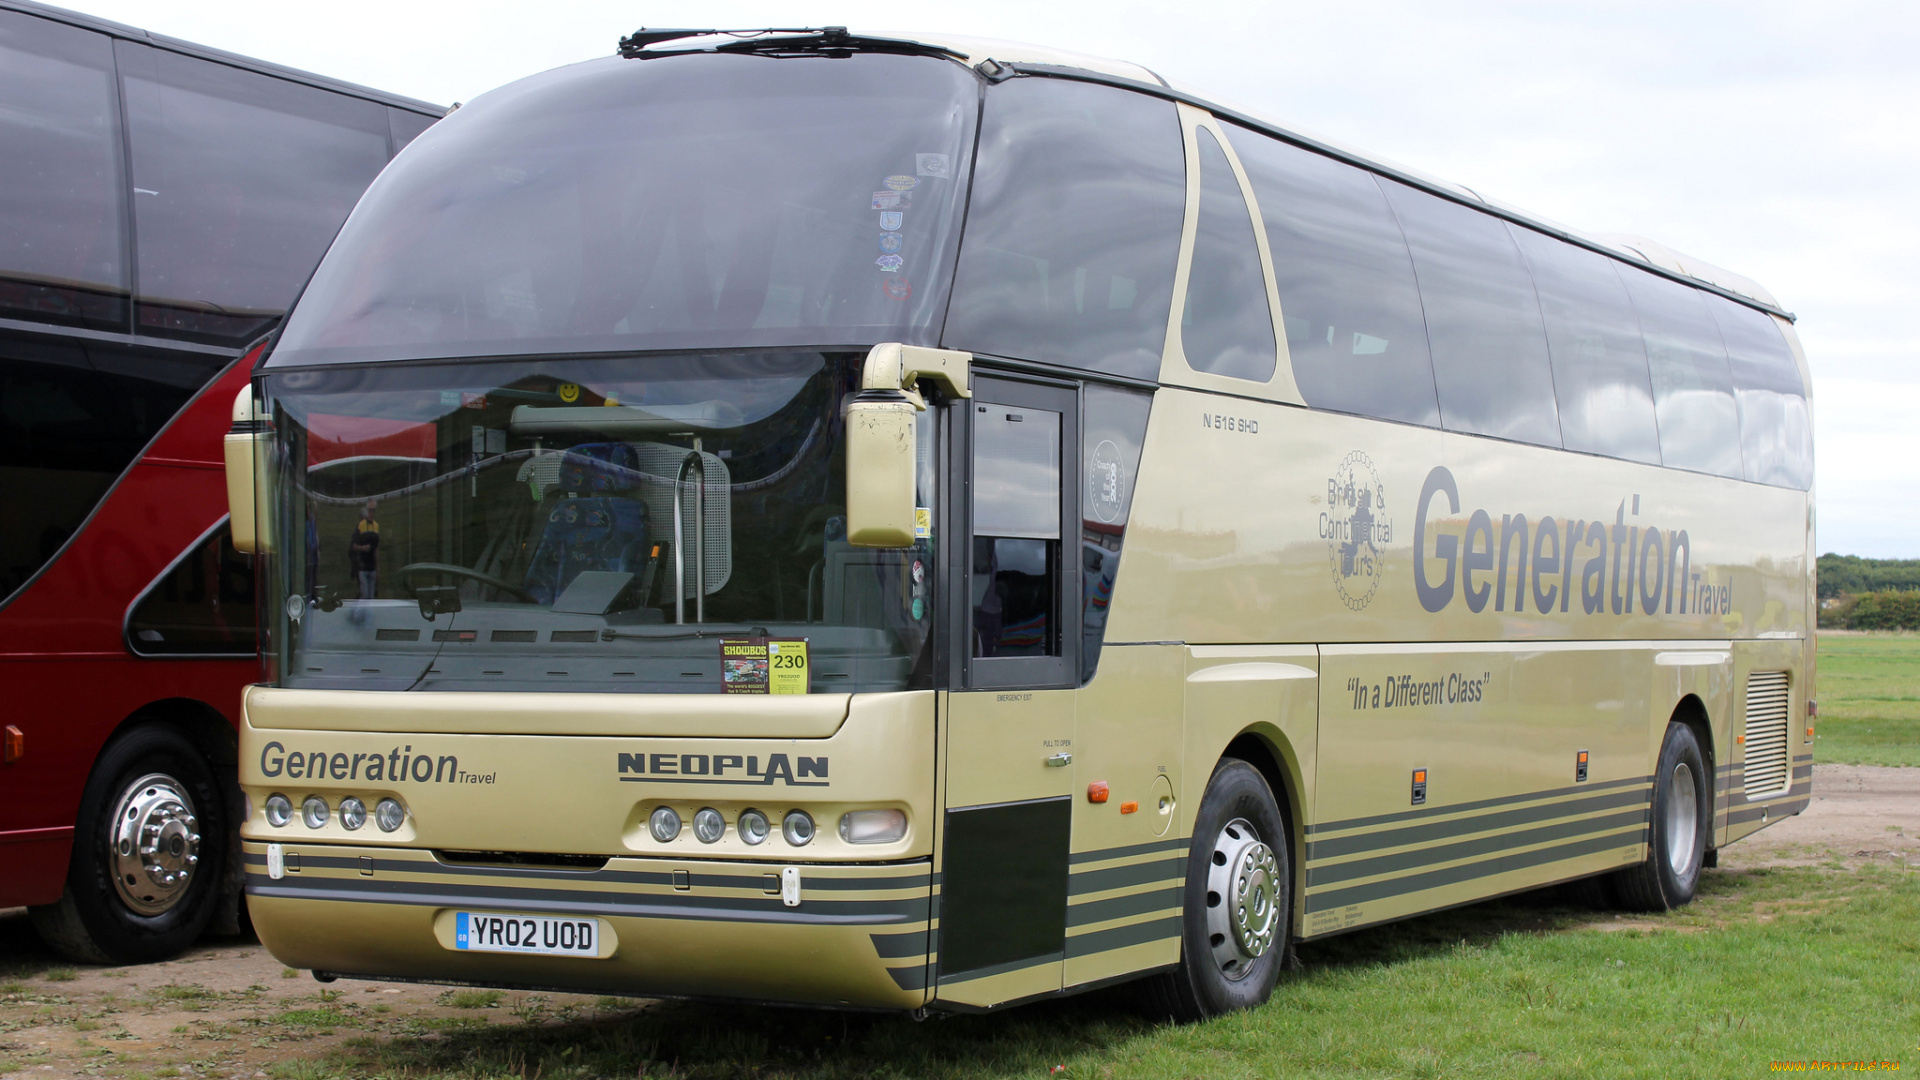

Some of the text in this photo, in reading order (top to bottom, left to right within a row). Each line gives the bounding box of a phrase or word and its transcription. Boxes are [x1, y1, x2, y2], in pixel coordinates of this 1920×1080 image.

[1203, 413, 1259, 434] N 516 SHD
[1097, 460, 1110, 470] Coach
[1101, 493, 1110, 502] Year
[1327, 478, 1385, 509] British &
[1319, 512, 1393, 544] Continental
[1414, 465, 1732, 616] Generation Travel
[1338, 548, 1373, 578] Tours
[724, 646, 766, 655] SHOWBUS
[774, 655, 804, 668] 230
[997, 693, 1032, 702] EMERGENCY EXIT
[1347, 672, 1490, 710] “In a Different Class”
[1060, 739, 1071, 747] OPEN
[261, 741, 495, 784] Generation Travel
[618, 752, 829, 786] NEOPLAN
[458, 934, 467, 942] GB
[474, 917, 592, 950] YR02 UOD
